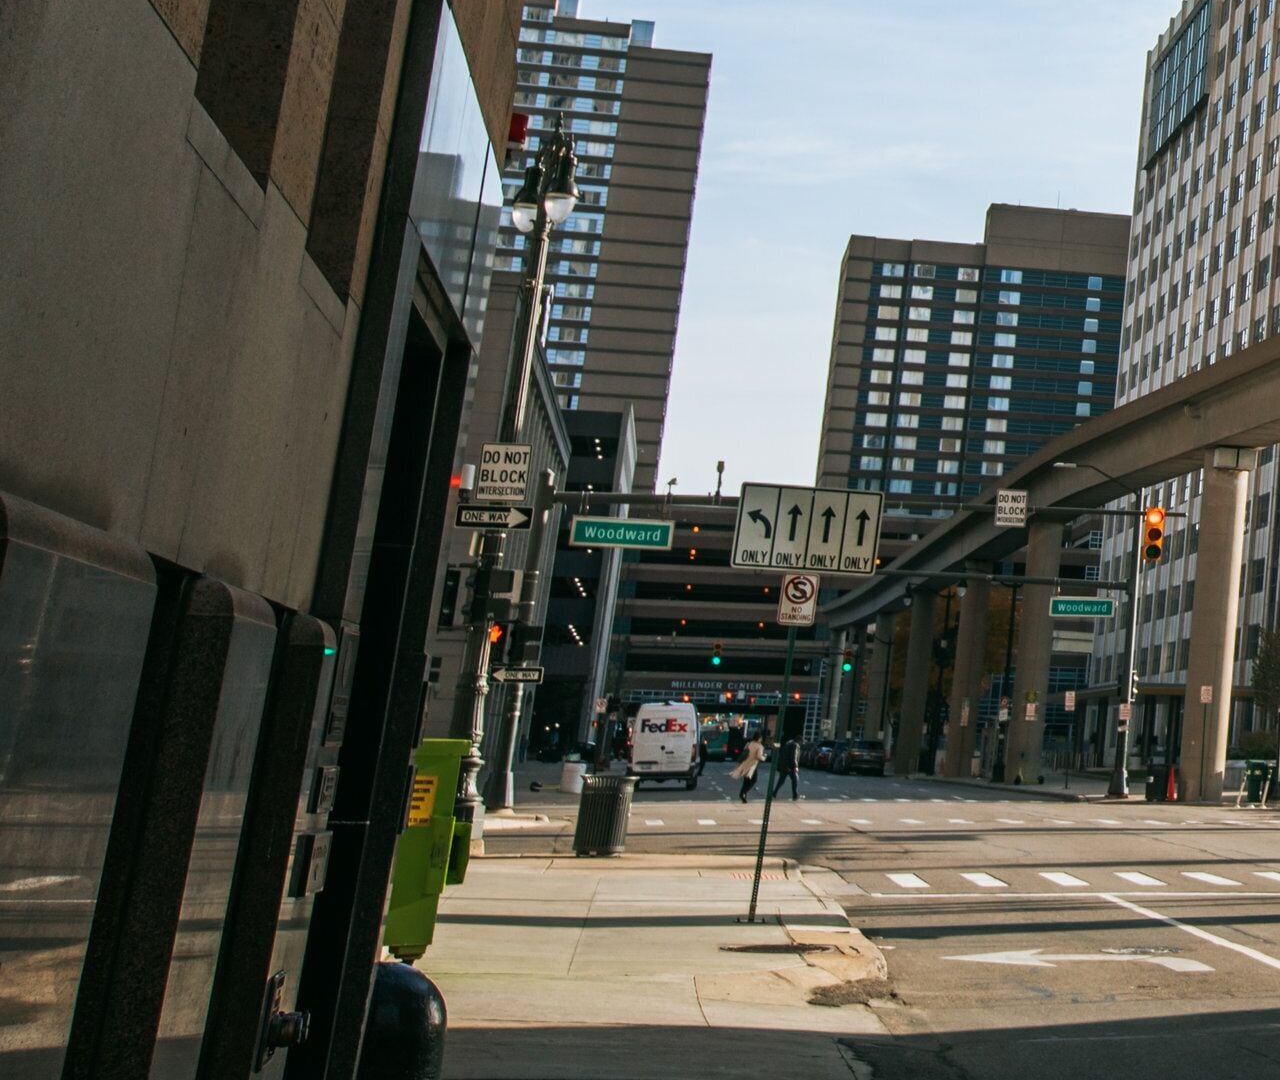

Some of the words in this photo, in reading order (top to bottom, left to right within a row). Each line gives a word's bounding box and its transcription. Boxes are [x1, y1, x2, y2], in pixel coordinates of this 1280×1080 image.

[483, 450, 500, 464] DO
[504, 451, 529, 465] NOT
[480, 469, 526, 484] BLOCK
[478, 485, 525, 497] INTERSECTION
[999, 494, 1009, 503] DO
[1011, 495, 1026, 504] NOT
[997, 506, 1025, 515] BLOCK
[464, 512, 486, 522] ONE
[488, 512, 511, 522] WAY
[585, 525, 662, 542] Woodward
[741, 549, 768, 564] ONLY
[775, 552, 802, 566] ONLY
[810, 554, 836, 568] ONLY
[844, 556, 870, 570] ONLY
[791, 606, 803, 614] NO
[1057, 603, 1108, 612] Woodward
[781, 612, 811, 622] STANDING
[505, 671, 520, 680] ONE
[521, 671, 537, 680] WAY
[671, 680, 723, 689] MILLENDER
[727, 681, 763, 690] CENTER
[640, 718, 688, 733] FedEx
